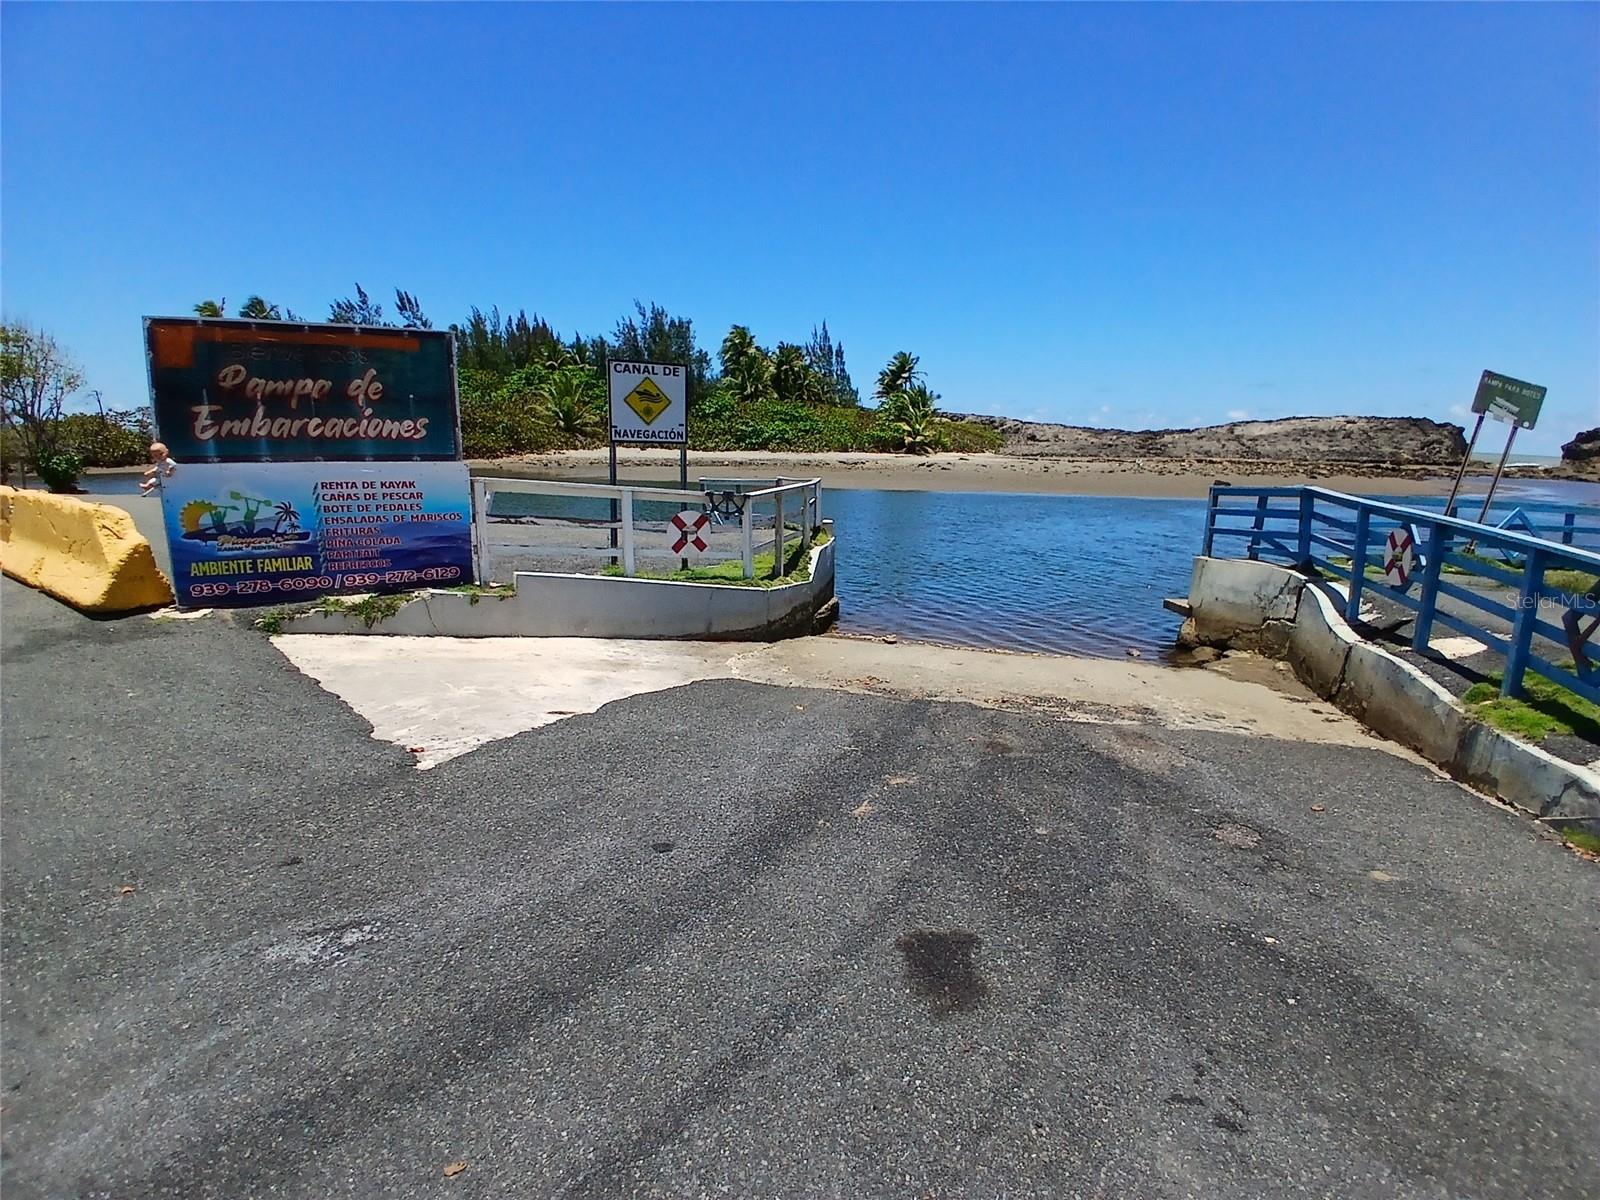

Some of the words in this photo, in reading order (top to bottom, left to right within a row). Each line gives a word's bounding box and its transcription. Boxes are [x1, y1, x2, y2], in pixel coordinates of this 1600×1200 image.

[613, 363, 659, 375] CANAL
[663, 366, 680, 377] DE
[346, 368, 383, 407] de
[191, 405, 430, 440] Embarcaciones
[614, 428, 684, 440] NAVEGACIÓN
[320, 481, 359, 490] RENTA
[362, 481, 377, 490] DE
[380, 480, 416, 489] KAYAK
[321, 491, 360, 501] CAÑAS
[364, 492, 378, 501] DE
[382, 492, 424, 500] PESCAR
[323, 504, 353, 514] BOTE
[357, 504, 372, 513] DE
[375, 503, 422, 512] PEDALES
[324, 515, 389, 525] ENSALADAS
[393, 514, 407, 524] DE
[411, 512, 463, 523] MARISCOS
[324, 527, 382, 537] FRITURAS
[357, 537, 401, 547] COLADA
[190, 560, 254, 576] AMBIENTE
[257, 556, 314, 573] FAMILIAR
[190, 576, 332, 597] 939-278-6090
[343, 566, 460, 586] 939-272-6129
